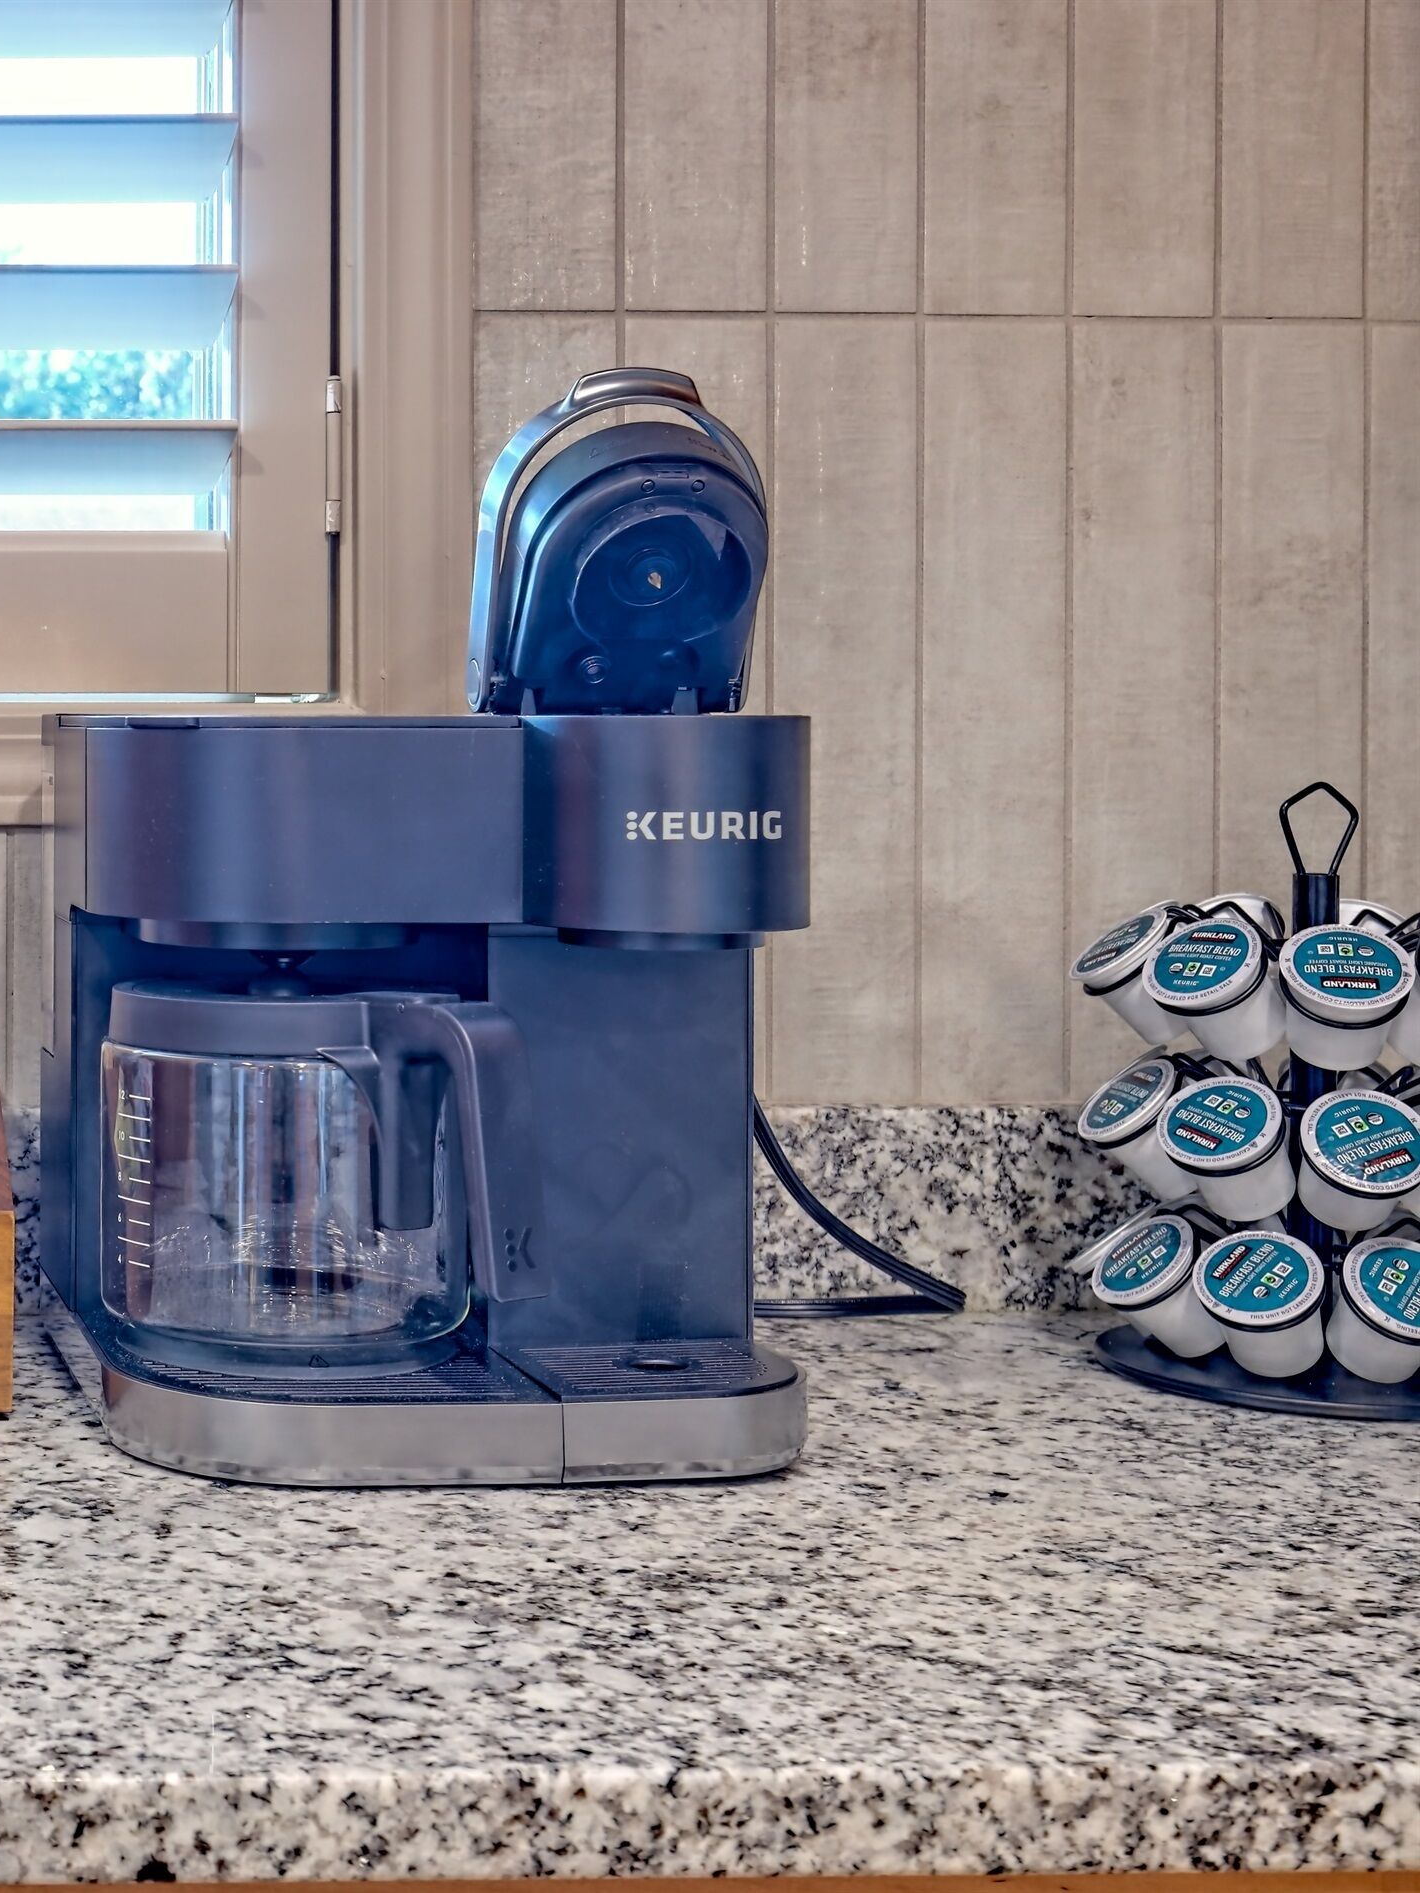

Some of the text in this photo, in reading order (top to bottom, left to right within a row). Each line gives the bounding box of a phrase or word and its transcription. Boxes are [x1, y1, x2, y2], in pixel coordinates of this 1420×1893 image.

[626, 810, 782, 841] KEURIG
[1191, 931, 1236, 940] KIRKLAND
[1168, 944, 1242, 957] BREAKFAST BLEND
[1303, 964, 1394, 977] BREAKFAST BLEND
[1322, 979, 1377, 989] KIRKLAND
[1226, 1090, 1251, 1102] KEURIG
[1175, 1109, 1202, 1125] BLEND
[1334, 1105, 1361, 1118] KEURIG
[117, 1130, 125, 1141] 10
[1199, 1116, 1245, 1144] BREAKFAST
[1175, 1128, 1217, 1150] KIRKLAND
[1336, 1131, 1415, 1165] BREAKFAST BLEND
[1364, 1154, 1412, 1175] KIRKLAND
[117, 1171, 122, 1181] 8
[117, 1213, 122, 1223] 6
[1105, 1226, 1168, 1278] BREAKFAST BLEND
[1111, 1228, 1149, 1260] KIRKLAND
[117, 1254, 122, 1264] 4
[1212, 1245, 1246, 1278] KIRKLAND
[1218, 1243, 1275, 1298] BREAKFAST BLEND
[1278, 1278, 1299, 1299] KEURIG
